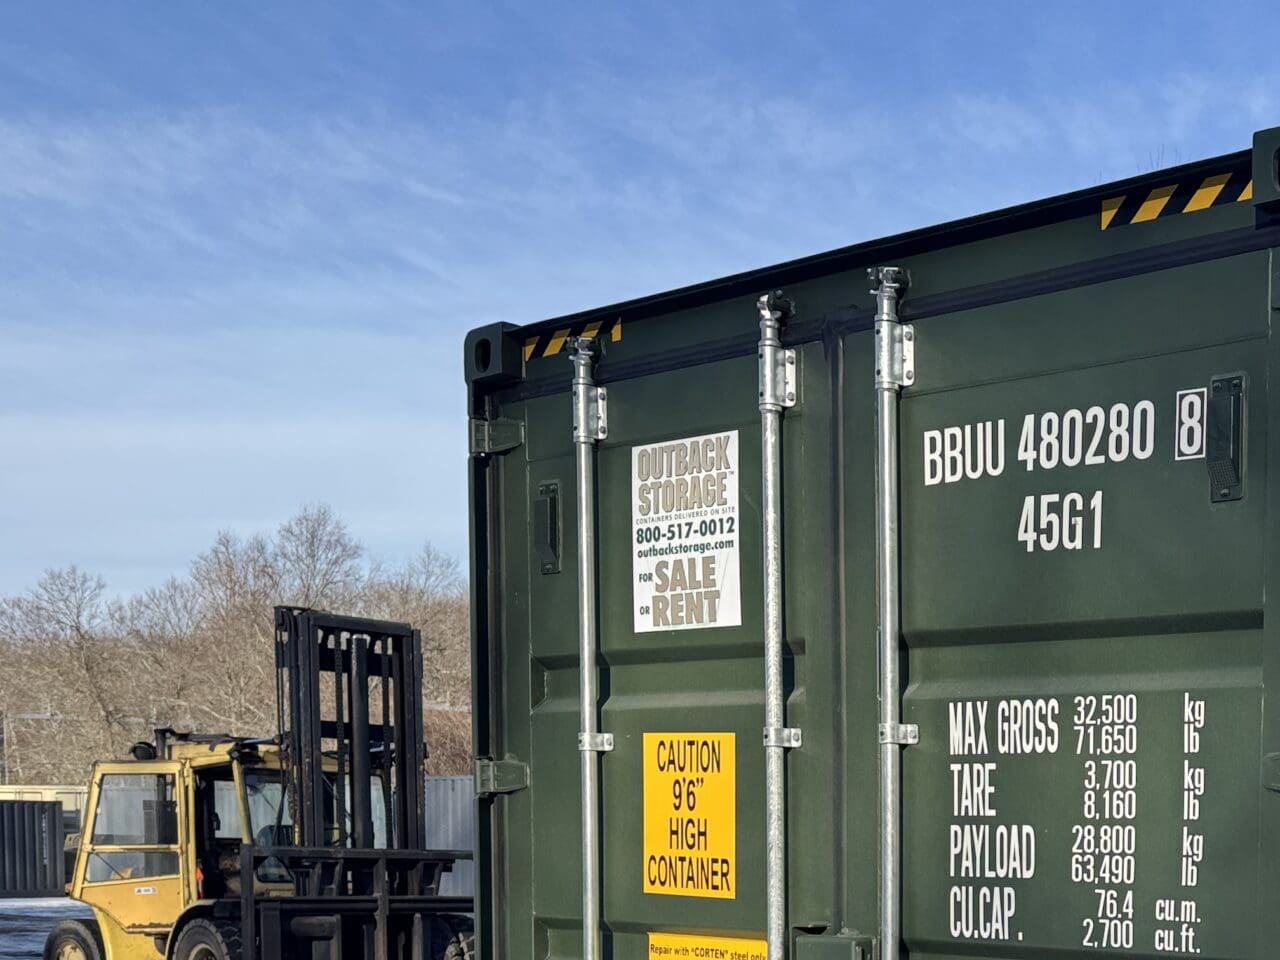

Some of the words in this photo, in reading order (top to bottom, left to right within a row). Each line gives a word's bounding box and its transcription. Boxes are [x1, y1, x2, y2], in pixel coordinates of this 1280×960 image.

[923, 419, 1005, 486] BBUU
[1017, 400, 1155, 472] 480280
[1179, 393, 1202, 455] 8
[637, 435, 731, 482] OUTBACK
[638, 471, 728, 516] STORAGE
[636, 513, 673, 525] CONTAINERS
[674, 509, 708, 520] DELIVERED
[710, 508, 719, 516] ON
[721, 506, 735, 514] SITE
[636, 516, 735, 544] 800-517-0012
[1017, 490, 1103, 552] 45G1
[637, 539, 734, 558] outbackstorage.com
[639, 572, 653, 583] FOR
[654, 555, 717, 593] SALE
[639, 606, 650, 615] OR
[652, 590, 720, 627] RENT
[949, 701, 988, 755] MAX
[998, 698, 1059, 754] GROSS
[1073, 694, 1137, 724] 32,500
[1184, 693, 1205, 727] kg
[657, 740, 721, 773] CAUTION
[1073, 724, 1137, 755] 71,650
[1184, 724, 1200, 753] lb
[950, 763, 996, 816] TARE
[1084, 760, 1136, 790] 3,700
[1184, 760, 1205, 795] kg
[1084, 790, 1136, 820] 8,160
[1183, 790, 1199, 820] lb
[669, 817, 707, 851] HIGH
[1072, 825, 1136, 854] 28,800
[1183, 827, 1204, 862] kg
[950, 824, 1036, 879] PAYLOAD
[648, 855, 731, 892] CONTAINER
[1071, 855, 1135, 884] 63,490
[1181, 857, 1198, 886] lb
[1095, 888, 1134, 919] 76.4
[1155, 899, 1201, 922] cu.m.
[650, 944, 672, 956] Repair
[674, 946, 690, 956] with
[730, 951, 749, 960] steel
[1082, 919, 1134, 949] 2,700
[1154, 924, 1200, 953] cu.ft.
